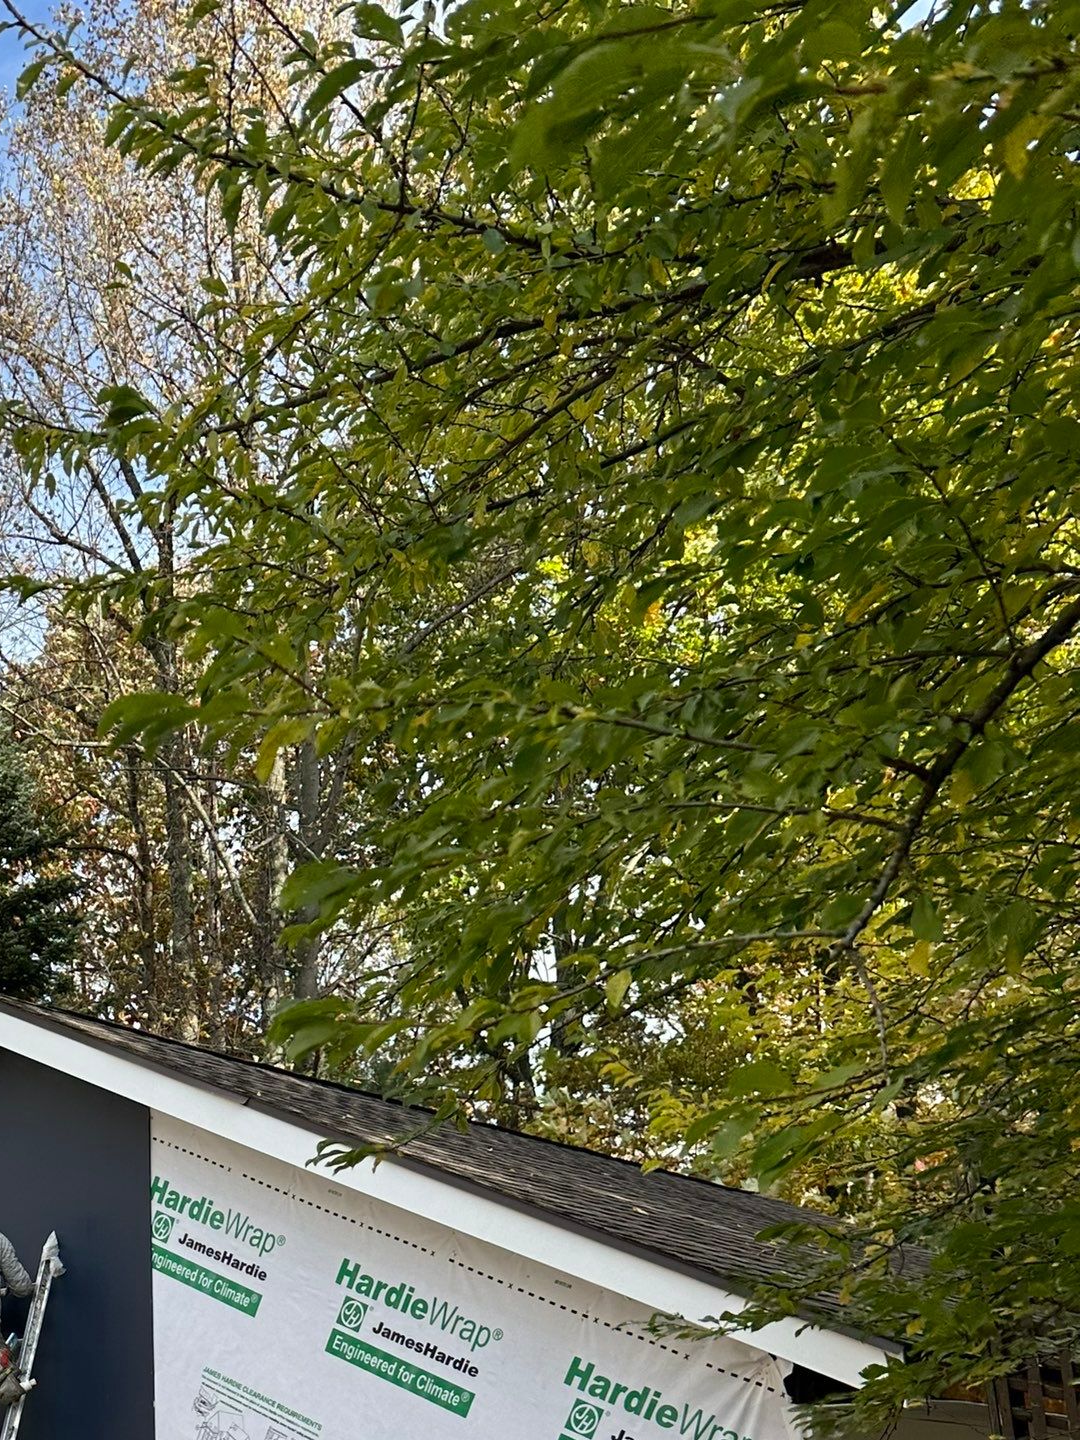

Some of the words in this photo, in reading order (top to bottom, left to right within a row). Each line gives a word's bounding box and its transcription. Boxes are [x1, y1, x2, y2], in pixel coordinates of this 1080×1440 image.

[152, 1248, 199, 1282] ngineered
[199, 1272, 212, 1289] for
[178, 1233, 267, 1281] JamesHardie
[332, 1334, 397, 1376] Engineered
[397, 1368, 415, 1385] for
[372, 1321, 479, 1378] JamesHardie
